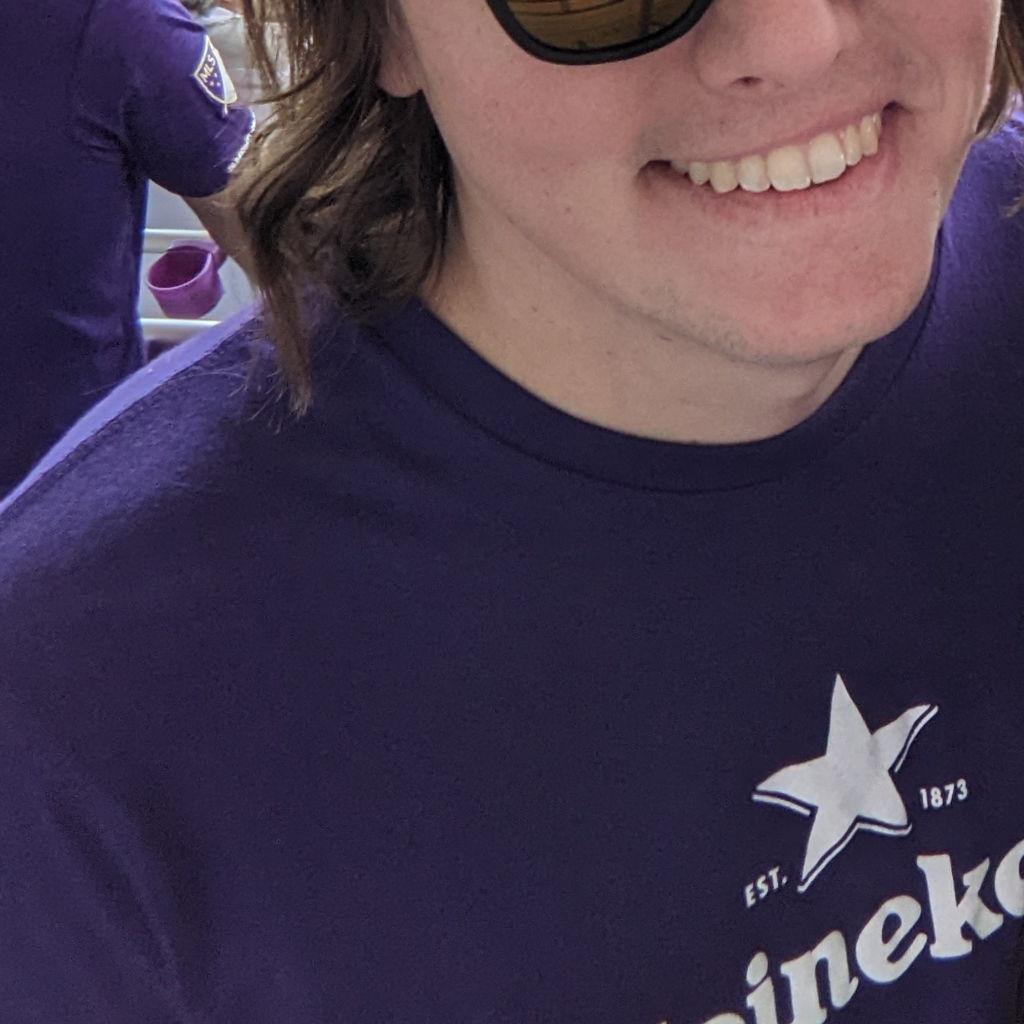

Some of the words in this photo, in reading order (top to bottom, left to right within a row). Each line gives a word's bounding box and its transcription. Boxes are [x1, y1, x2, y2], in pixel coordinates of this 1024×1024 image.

[199, 54, 215, 83] MLS
[919, 778, 969, 810] 1873
[743, 865, 789, 909] EST.
